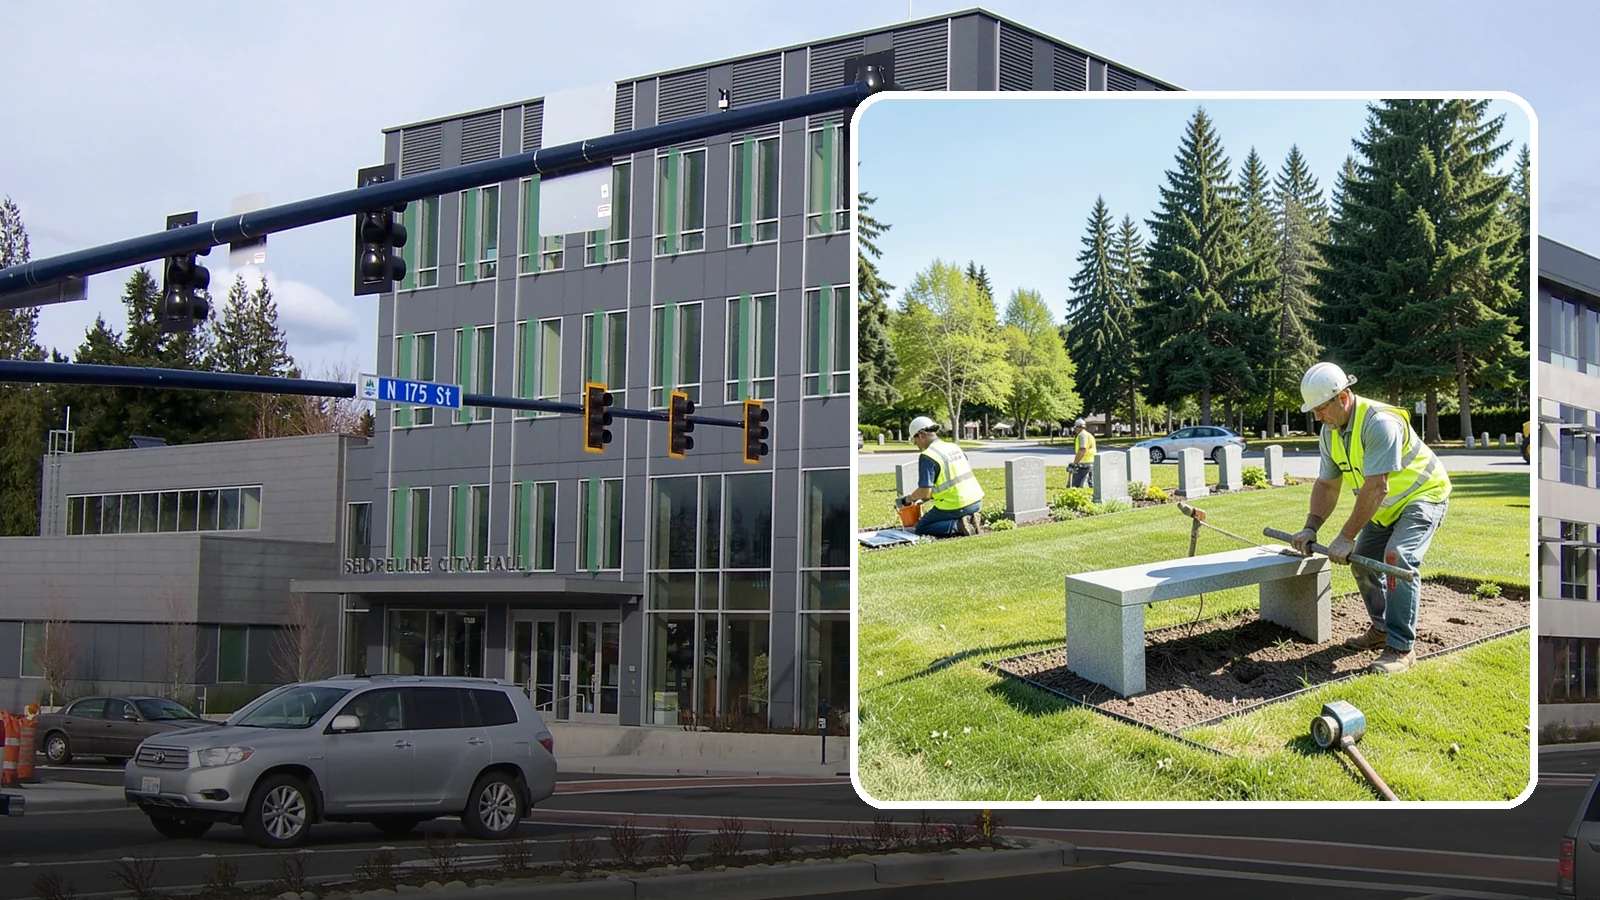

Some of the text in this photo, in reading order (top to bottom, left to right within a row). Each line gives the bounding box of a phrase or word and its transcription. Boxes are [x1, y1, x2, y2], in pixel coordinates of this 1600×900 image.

[387, 380, 451, 406] N 175 St
[344, 555, 526, 574] SHORELINE CITY HALL
